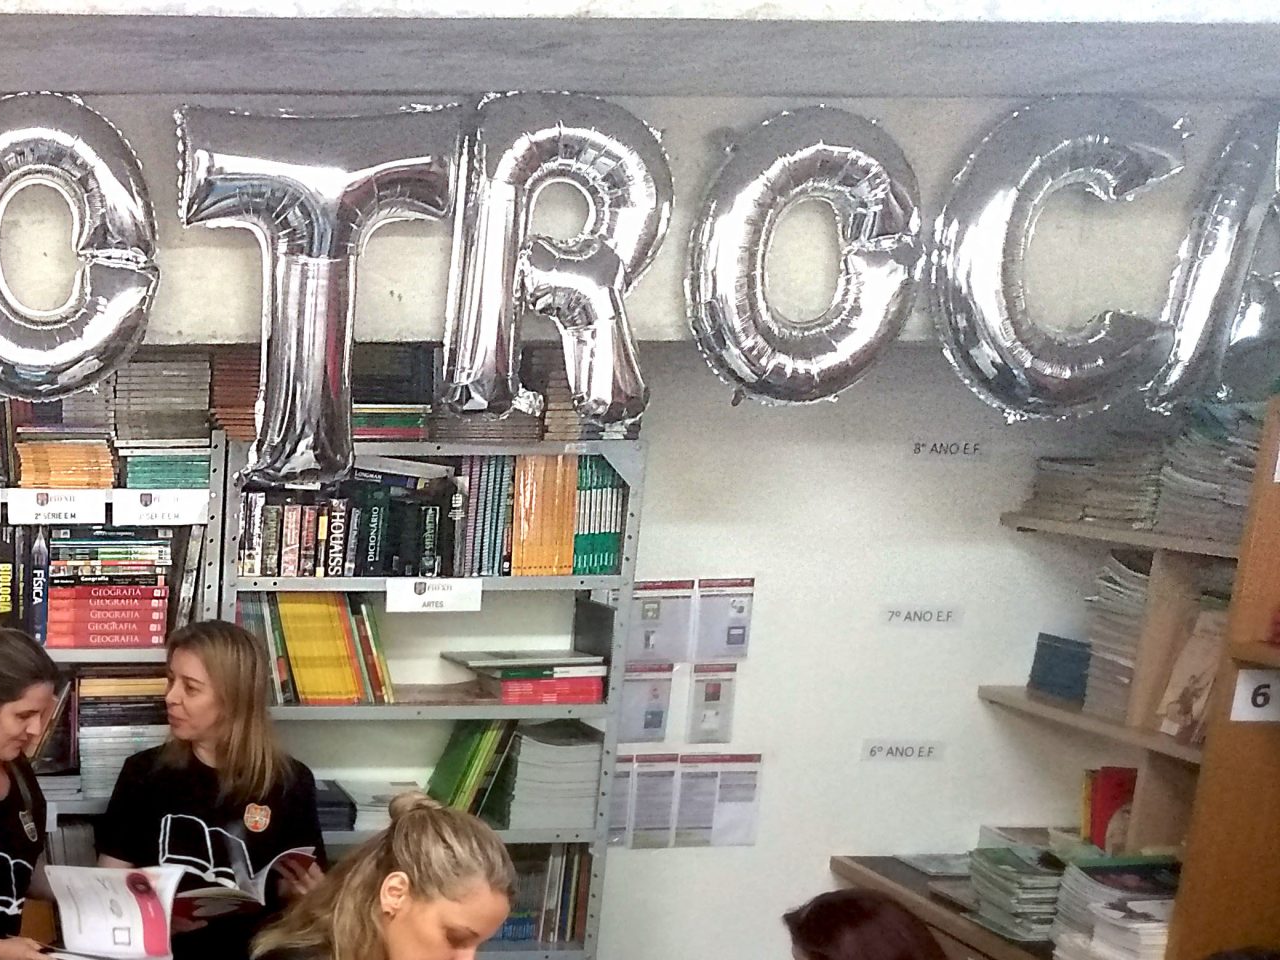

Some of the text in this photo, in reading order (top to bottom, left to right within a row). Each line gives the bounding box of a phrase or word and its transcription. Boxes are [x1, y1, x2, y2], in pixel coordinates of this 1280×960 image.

[929, 442, 960, 455] ANO
[367, 506, 380, 562] DICIONÁRIO
[328, 511, 346, 576] HOUAISS
[80, 575, 109, 583] Geografia
[0, 563, 13, 614] BIOLOGIA
[32, 569, 47, 605] FÍSICA
[91, 587, 142, 597] GEOGRAFIA
[89, 598, 139, 606] GEOGRAFIA
[421, 600, 444, 609] ARTES
[89, 610, 140, 619] GEOGRAFIA
[903, 610, 933, 622] ANO
[87, 621, 138, 631] GEOGRAFIA
[89, 634, 140, 643] GEOGRAFIA
[1251, 683, 1271, 708] 6
[885, 746, 915, 758] ANO
